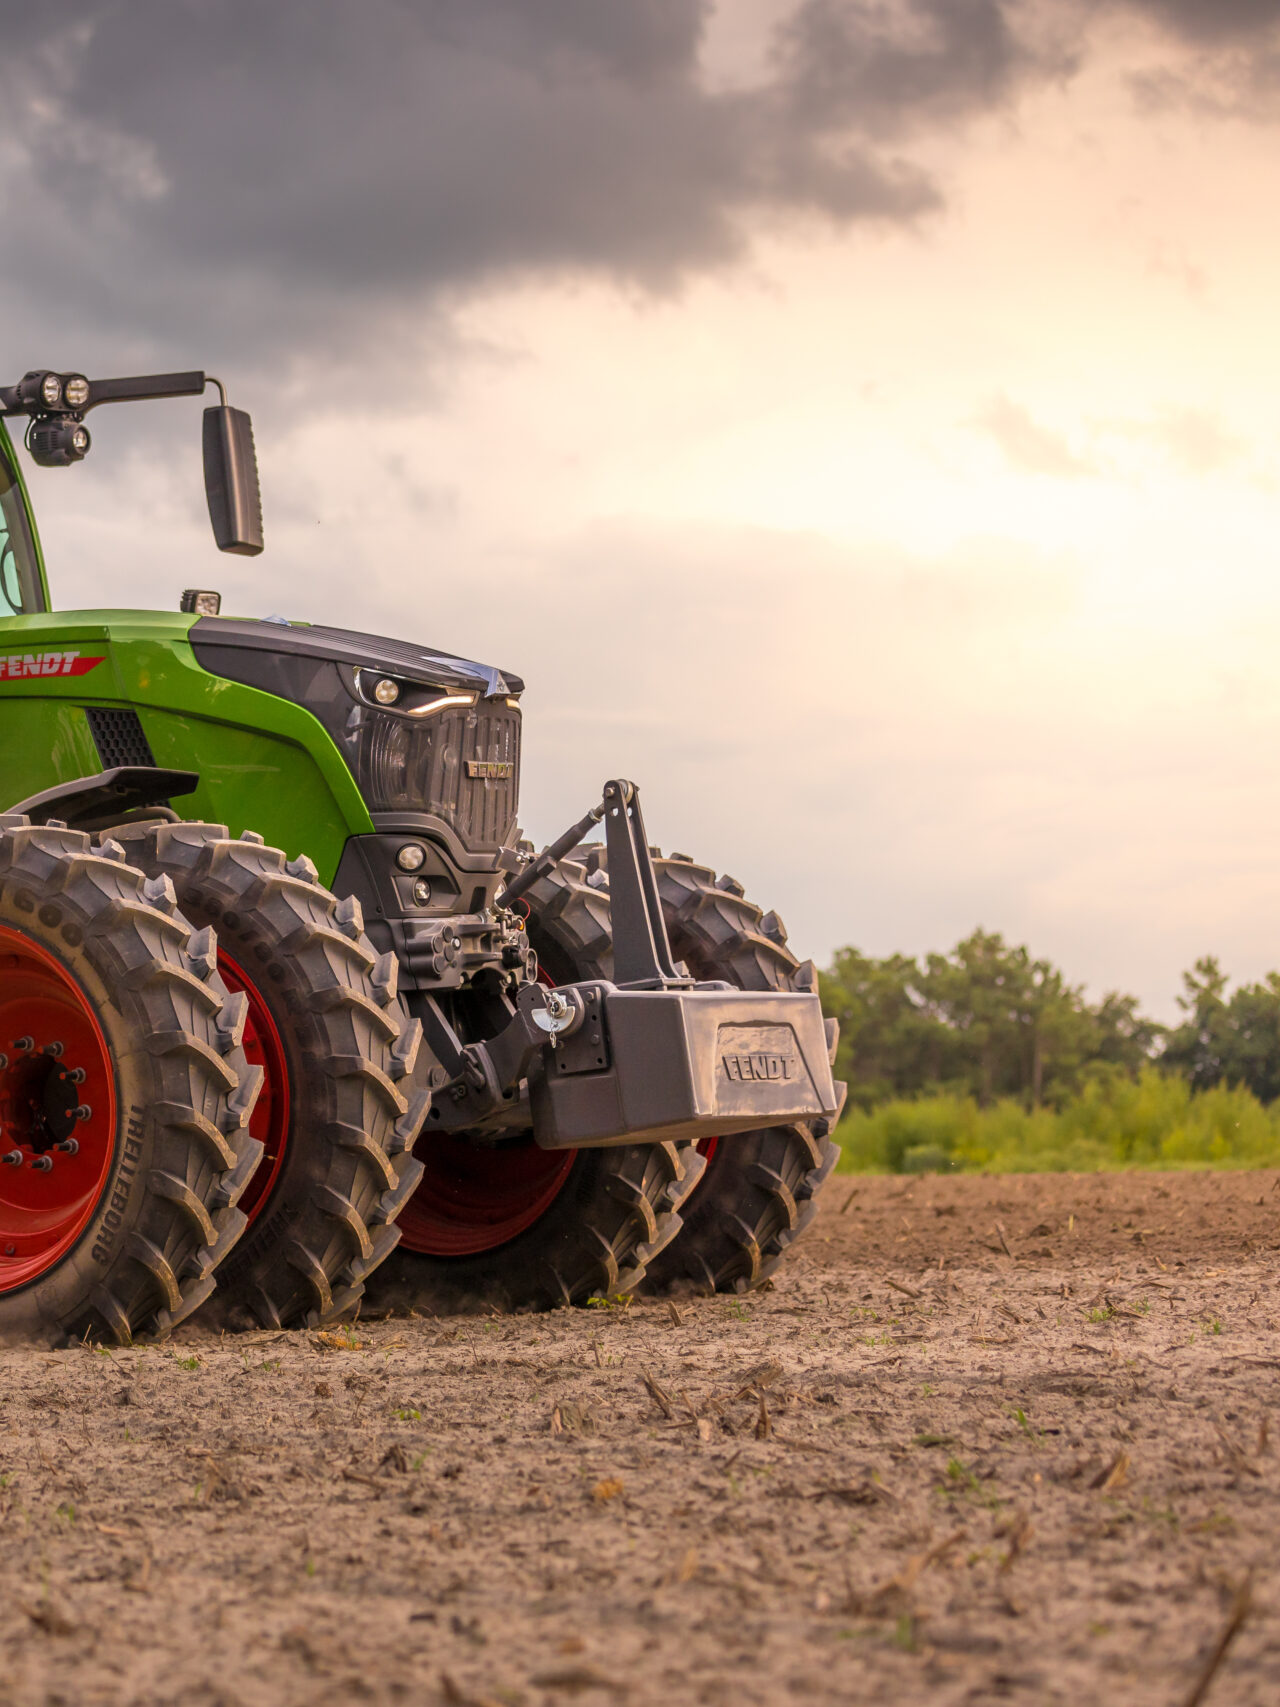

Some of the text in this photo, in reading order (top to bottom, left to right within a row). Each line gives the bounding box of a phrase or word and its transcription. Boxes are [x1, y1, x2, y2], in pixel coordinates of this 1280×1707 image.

[469, 762, 514, 778] FENDT
[722, 1055, 795, 1081] FENDT
[91, 1104, 146, 1266] TRELLEBORG
